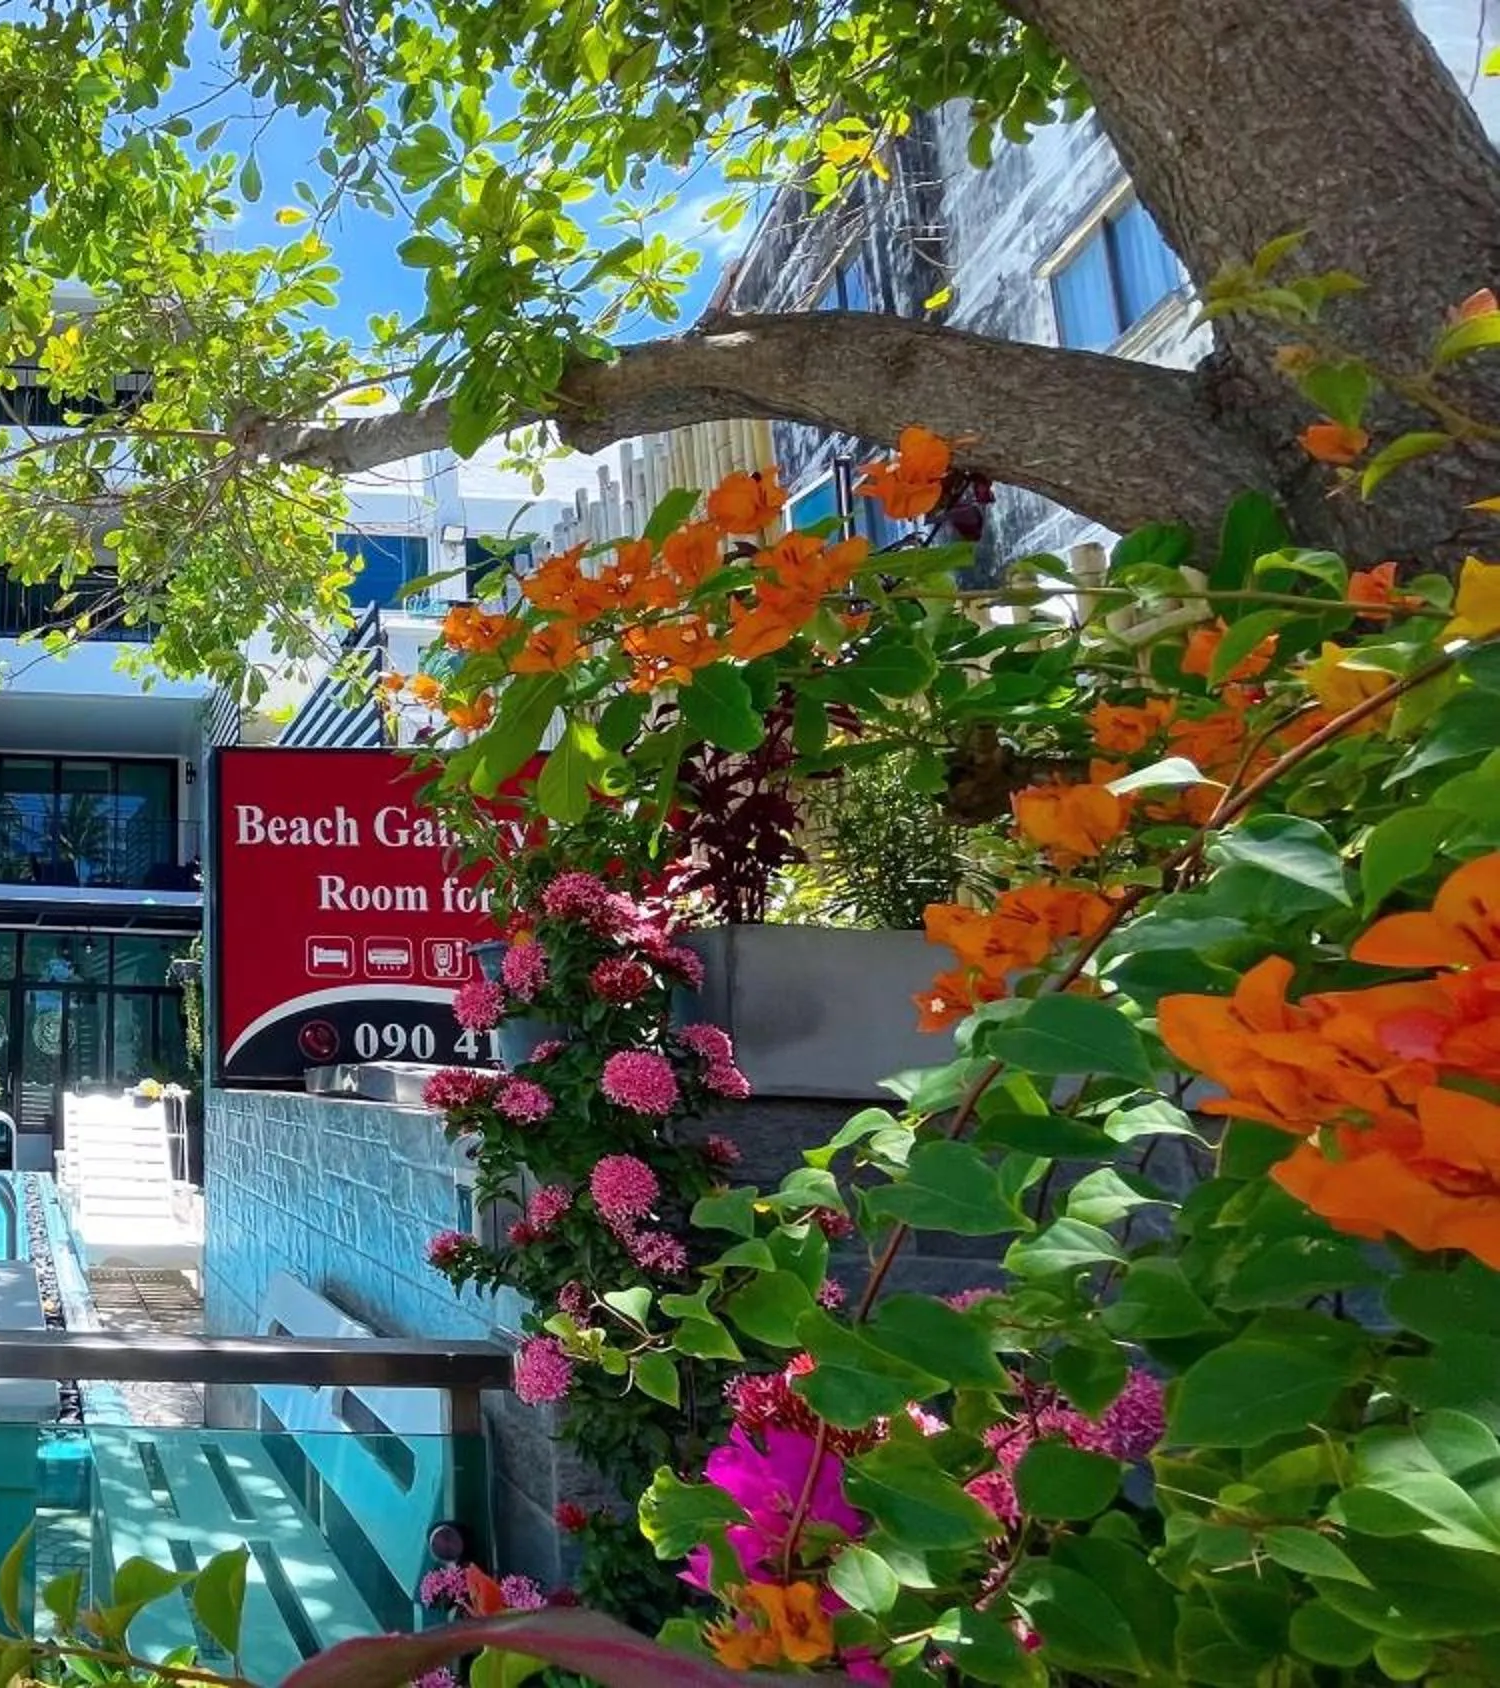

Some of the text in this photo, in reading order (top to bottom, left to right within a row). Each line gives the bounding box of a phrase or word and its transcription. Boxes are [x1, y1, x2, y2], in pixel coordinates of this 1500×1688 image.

[234, 804, 360, 846] Beach
[316, 874, 429, 912] Room
[441, 876, 496, 913] for
[354, 1022, 436, 1060] 090
